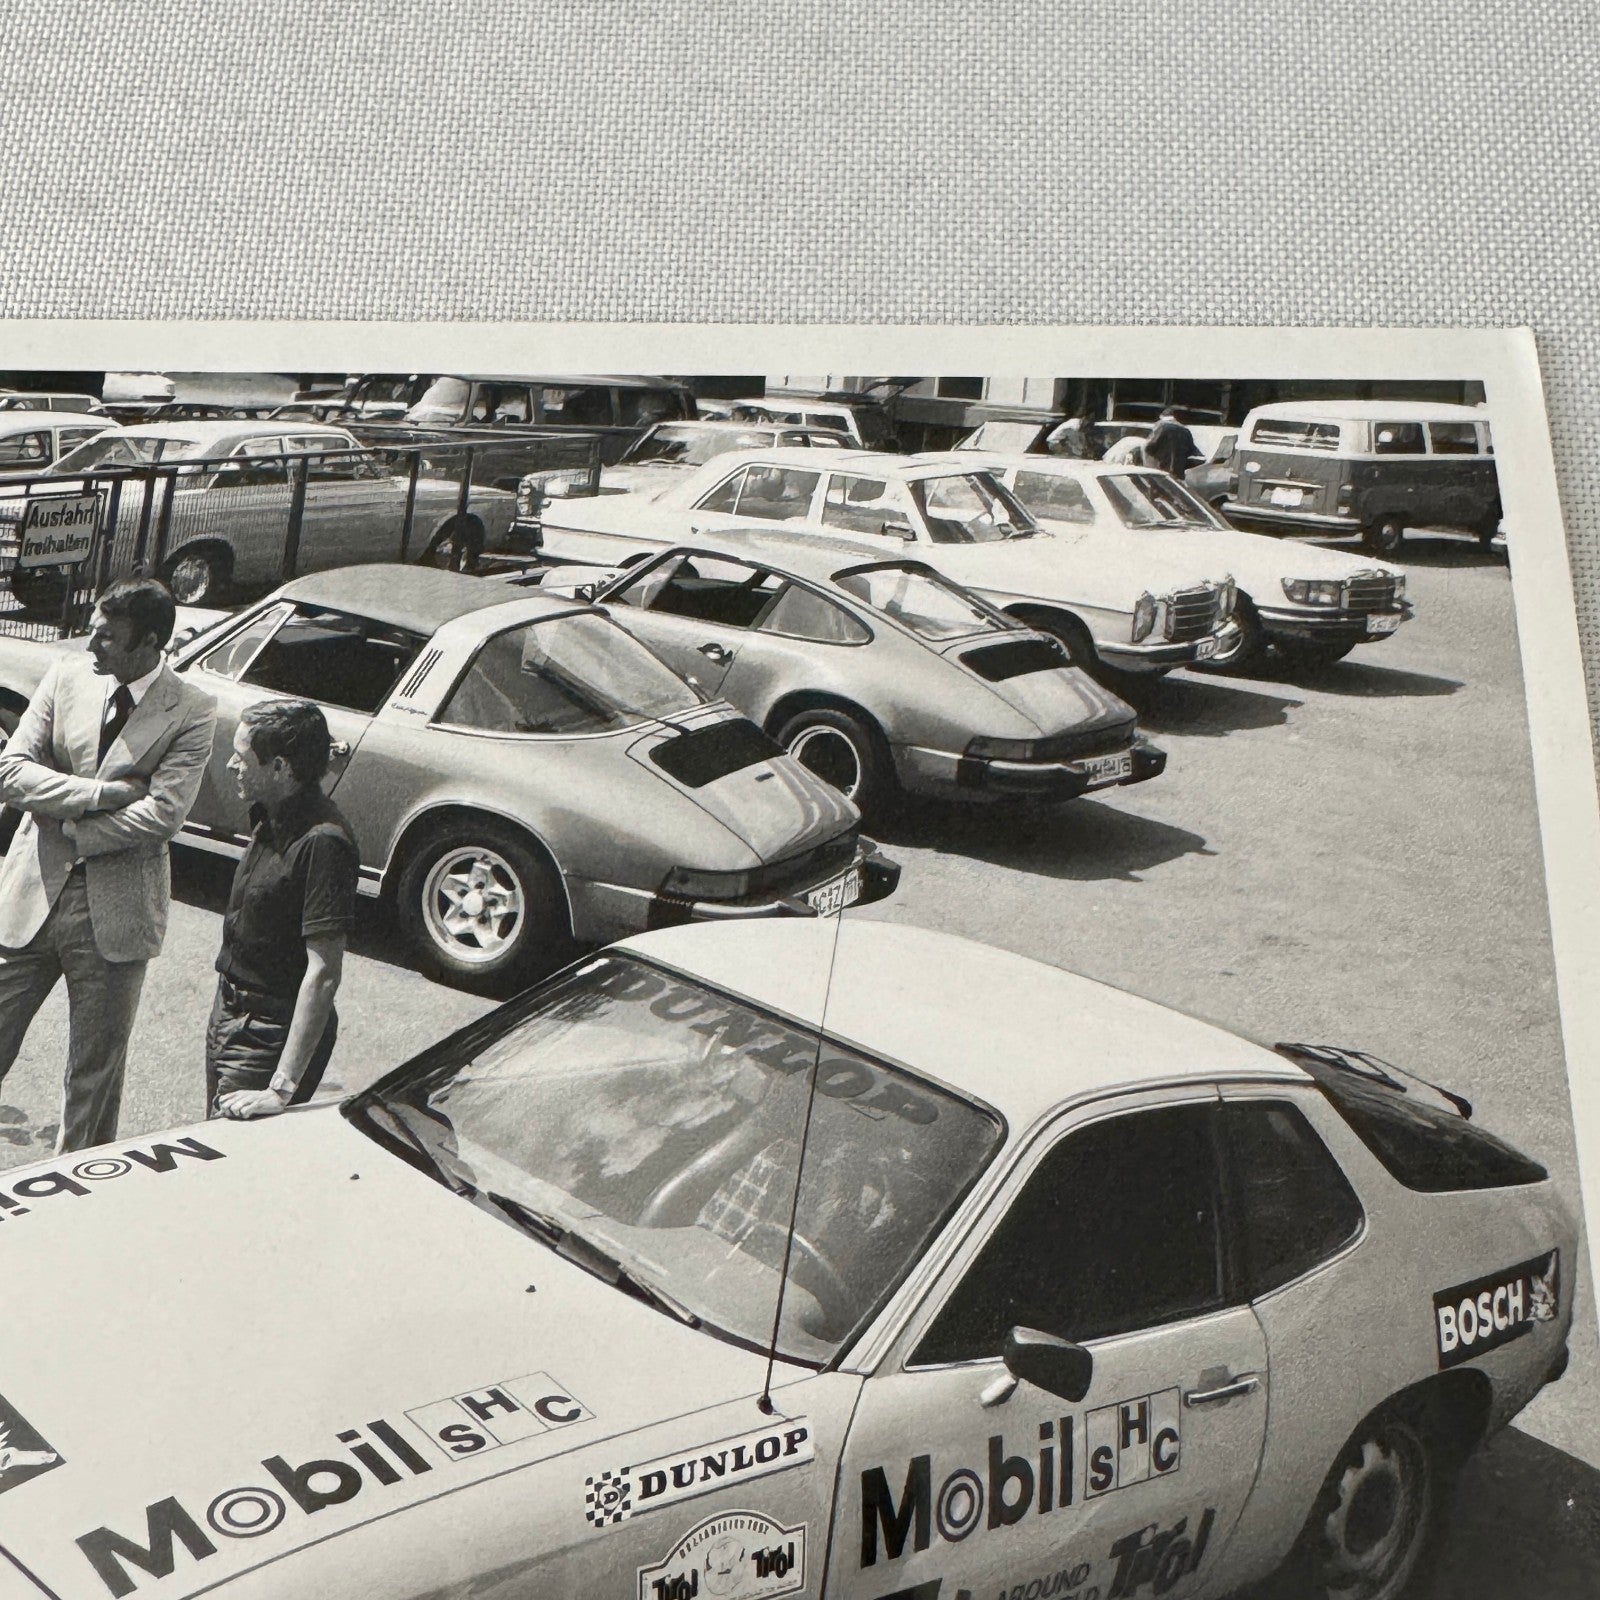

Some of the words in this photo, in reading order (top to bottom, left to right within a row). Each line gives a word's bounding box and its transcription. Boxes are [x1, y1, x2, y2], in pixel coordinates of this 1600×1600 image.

[0, 1137, 227, 1221] Mobi
[1438, 1279, 1523, 1353] BOSCH
[75, 1419, 432, 1599] Mobil
[438, 1388, 582, 1453] SHC
[638, 1427, 808, 1501] DUNLOP
[861, 1415, 1074, 1569] Mobil
[1090, 1401, 1179, 1490] SHC
[751, 1541, 795, 1578] Tirol
